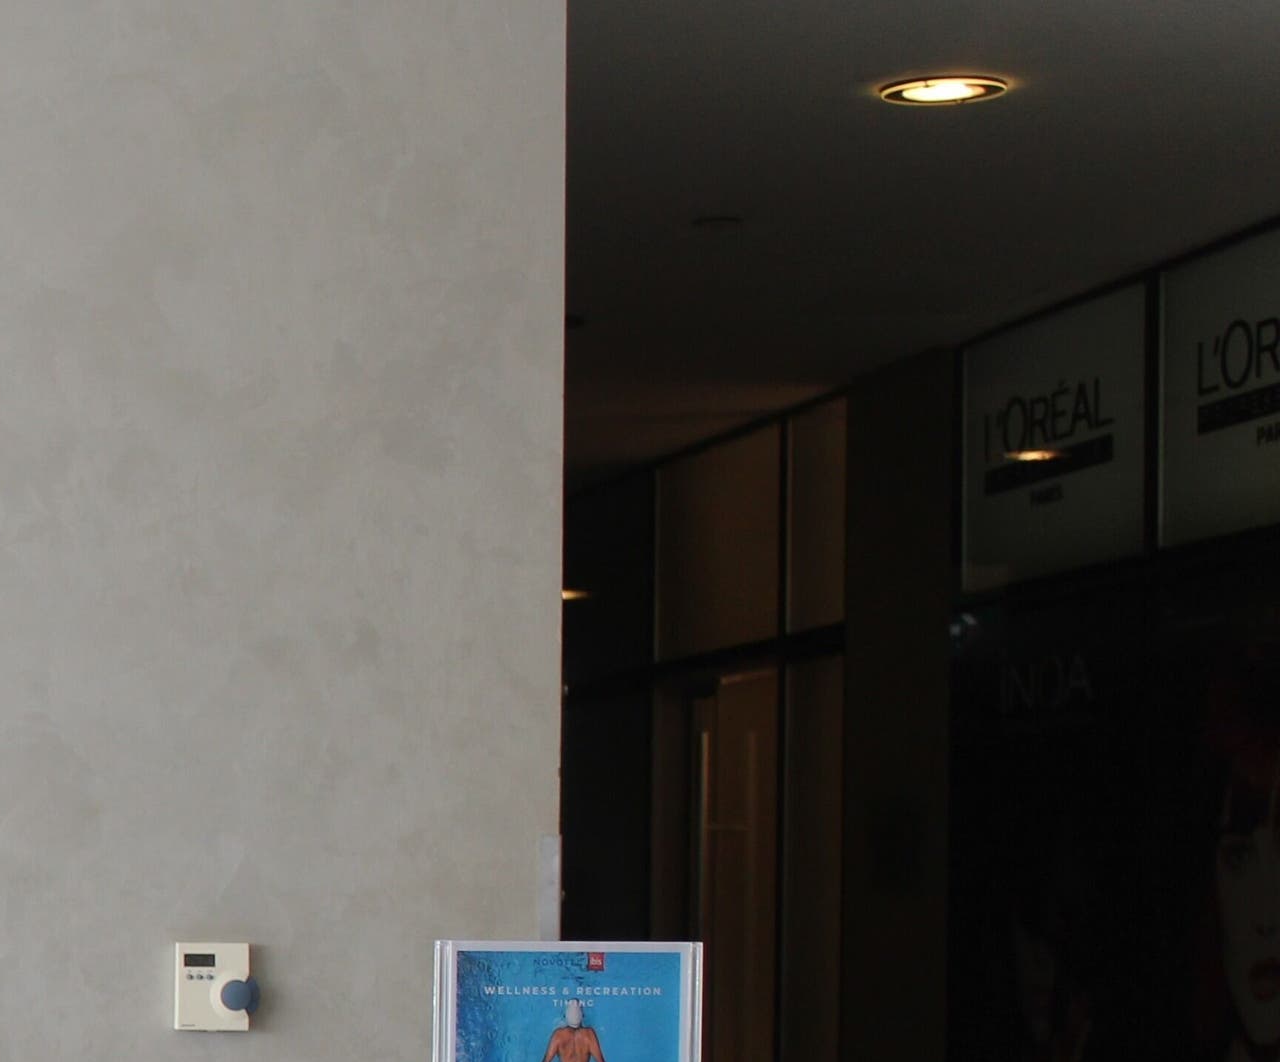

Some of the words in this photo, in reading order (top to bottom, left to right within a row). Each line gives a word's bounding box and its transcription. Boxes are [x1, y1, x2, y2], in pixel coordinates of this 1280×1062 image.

[484, 986, 556, 996] WELLNESS
[576, 986, 662, 996] RECREATION
[552, 999, 595, 1008] TIMNG
